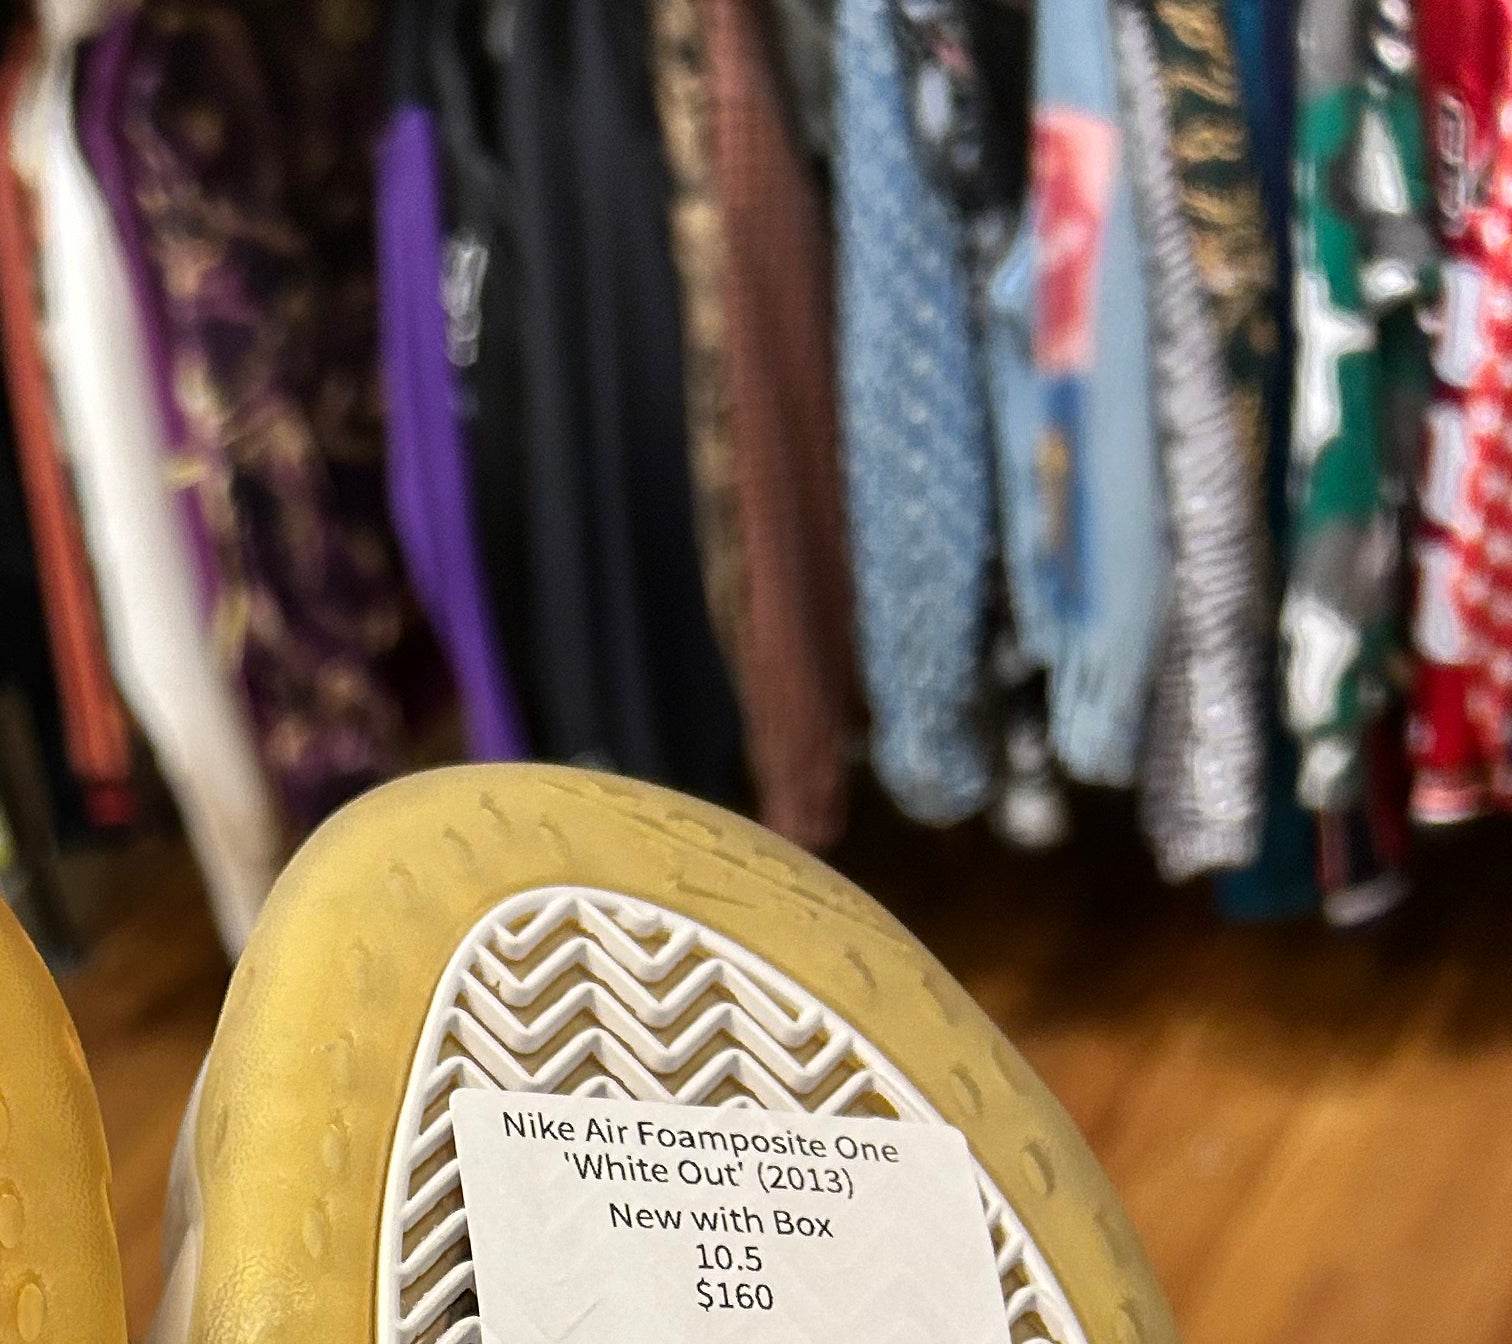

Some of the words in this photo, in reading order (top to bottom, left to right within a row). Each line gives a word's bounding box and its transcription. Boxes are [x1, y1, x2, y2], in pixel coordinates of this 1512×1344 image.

[503, 1112, 575, 1142] Nike
[585, 1118, 628, 1145] Air
[637, 1121, 827, 1158] Foamposite
[835, 1136, 899, 1163] One
[564, 1152, 669, 1184] 'White
[678, 1160, 744, 1187] Out'
[757, 1162, 854, 1199] (2013)
[609, 1203, 681, 1230] New
[690, 1206, 765, 1234] with
[773, 1210, 834, 1239] Box
[696, 1244, 763, 1272] 10.5
[697, 1277, 774, 1312] $160
